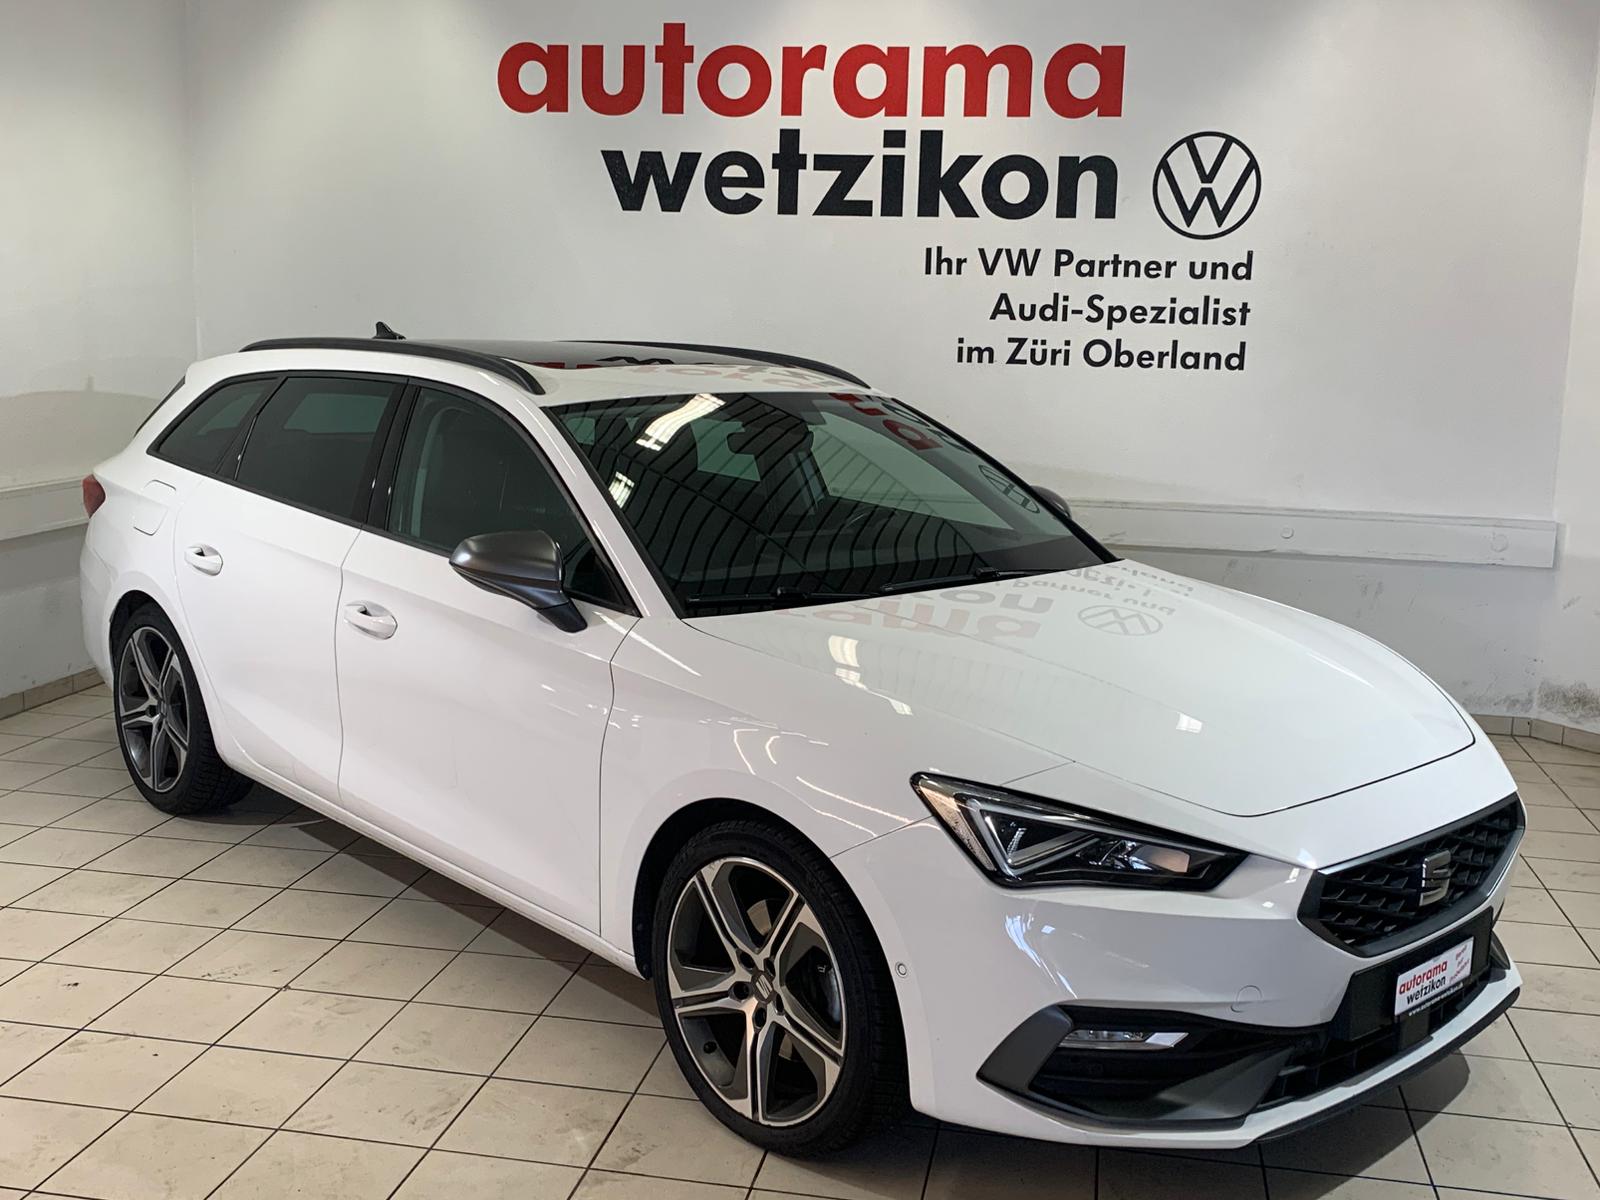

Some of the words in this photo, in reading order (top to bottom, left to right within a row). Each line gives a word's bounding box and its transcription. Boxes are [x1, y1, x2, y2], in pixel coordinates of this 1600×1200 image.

[498, 23, 1126, 118] autorama
[601, 129, 1119, 220] wetzikon
[925, 246, 968, 275] Ihr
[978, 248, 1041, 276] VW
[1054, 249, 1178, 279] Partner
[1189, 251, 1253, 281] und
[990, 293, 1250, 330] Audi-Spezialist
[958, 338, 994, 363] im
[1005, 338, 1070, 366] Züri
[1083, 339, 1246, 370] Oberland
[1399, 960, 1448, 995] autorama
[1406, 976, 1447, 1005] wetzikon
